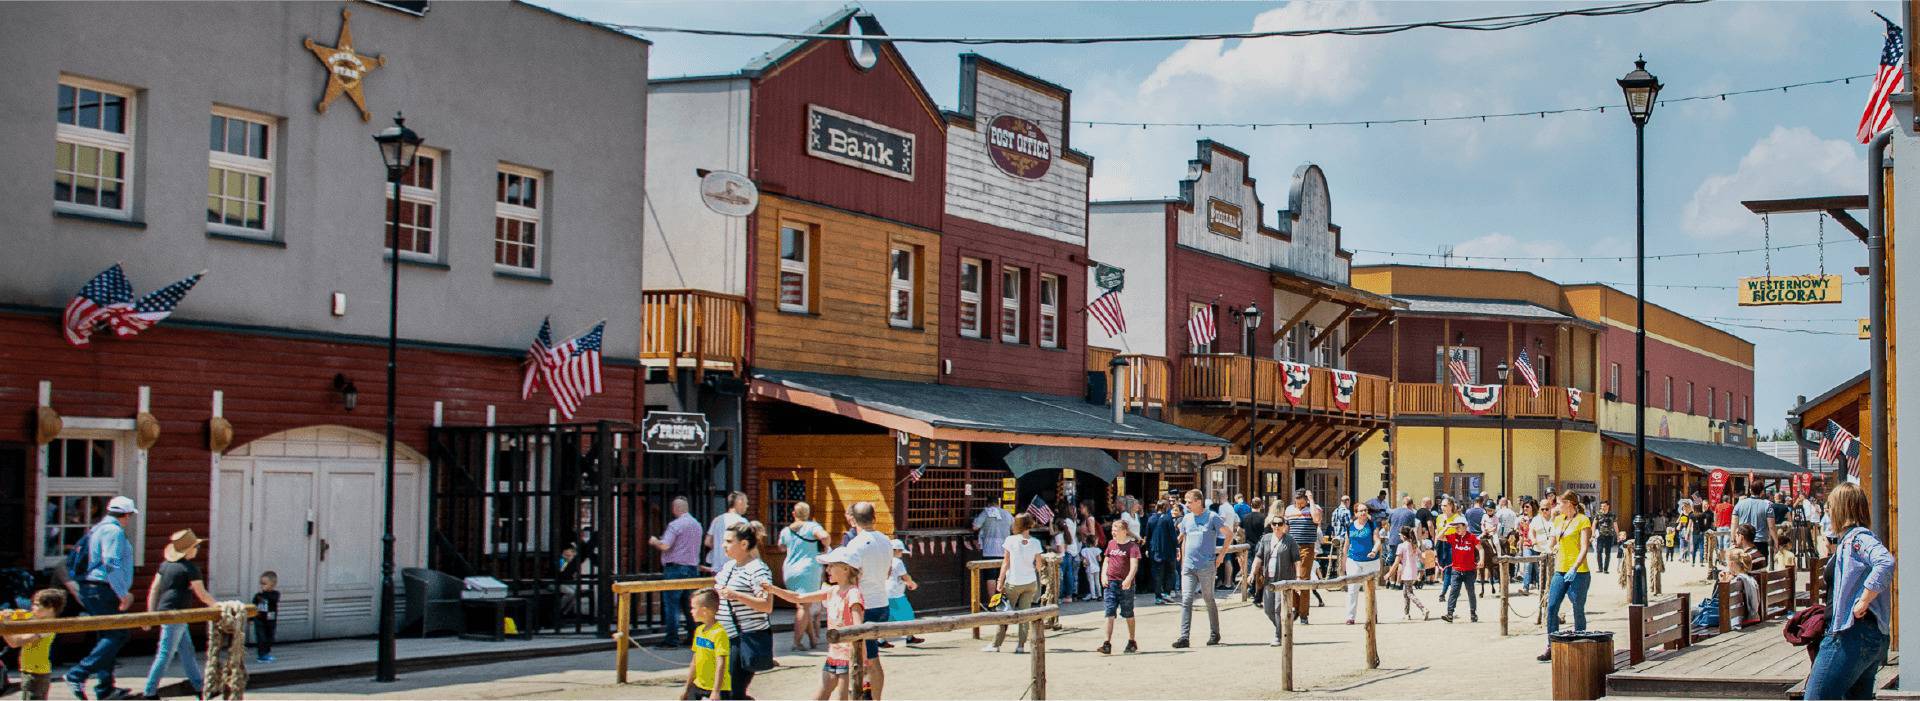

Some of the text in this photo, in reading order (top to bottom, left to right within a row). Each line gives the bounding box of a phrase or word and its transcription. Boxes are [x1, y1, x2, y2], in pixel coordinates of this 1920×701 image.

[828, 128, 894, 167] Bank
[991, 126, 1015, 150] POST
[1016, 133, 1049, 160] OFFICE
[1748, 279, 1830, 291] WESTERNOWY
[1752, 289, 1826, 303] FIGLORAJ
[659, 424, 694, 440] PRISON
